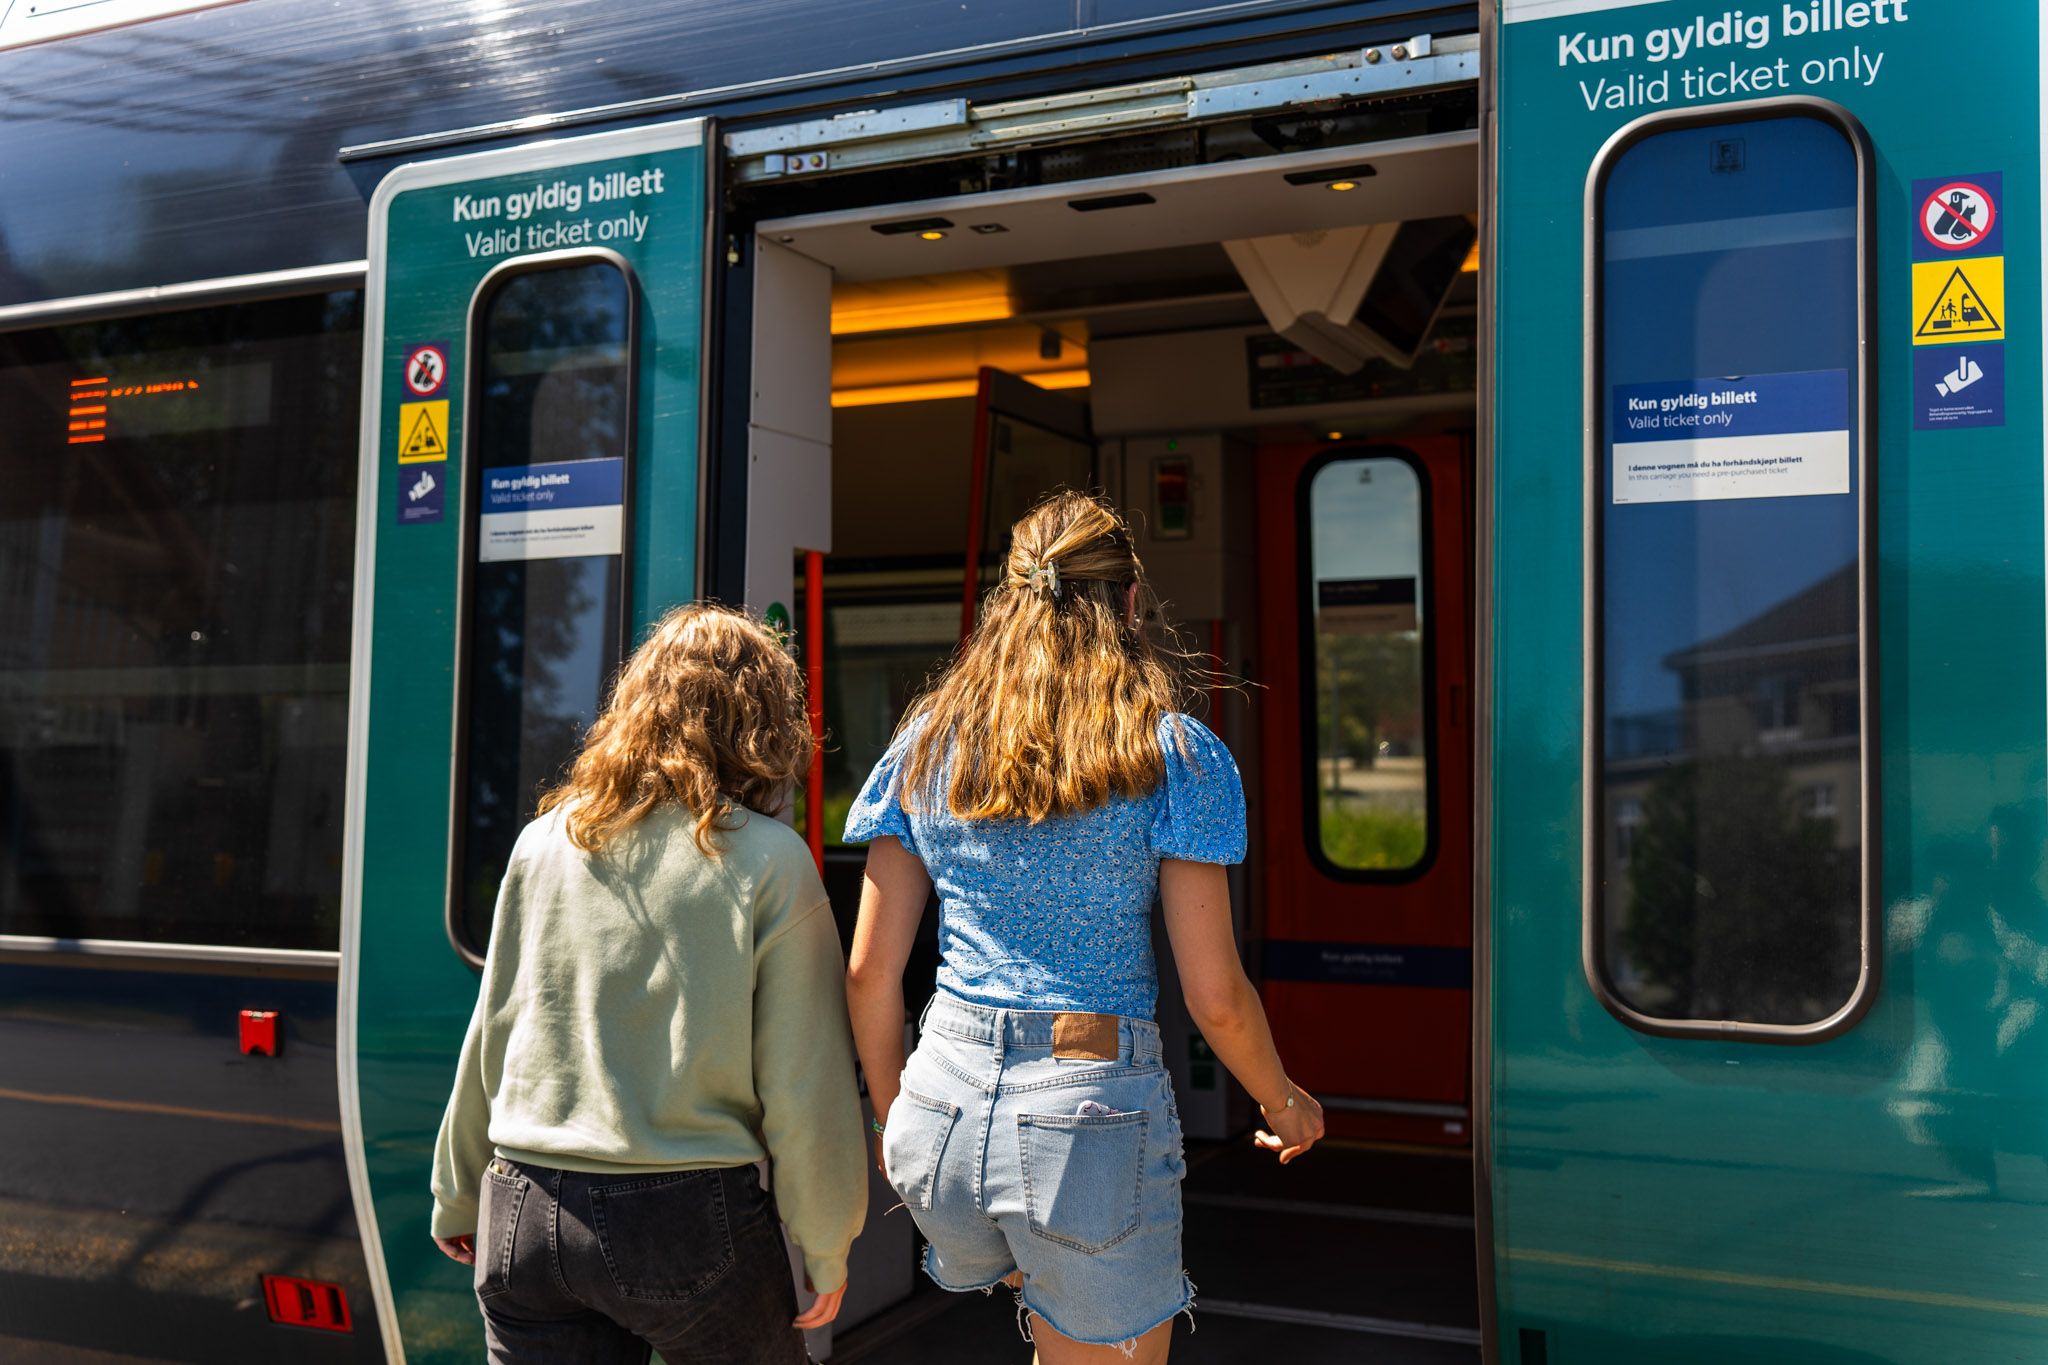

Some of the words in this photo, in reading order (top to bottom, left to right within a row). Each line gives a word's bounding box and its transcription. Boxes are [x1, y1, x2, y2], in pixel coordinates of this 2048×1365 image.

[1557, 31, 1635, 66] Kun
[1645, 11, 1769, 61] gyldig
[1781, 0, 1910, 37] billett
[1579, 69, 1670, 112] Valid
[1680, 57, 1791, 99] ticket
[1800, 45, 1885, 86] only
[452, 194, 501, 223] Kun
[505, 180, 583, 220] gyldig
[587, 167, 665, 202] billett
[465, 225, 521, 258] Valid
[526, 218, 593, 250] ticket
[597, 209, 649, 243] only
[1628, 397, 1658, 411] Kun
[1660, 391, 1708, 412] gyldig
[1711, 390, 1758, 407] billett
[1628, 415, 1660, 430] Valid
[1663, 412, 1700, 427] ticket
[1703, 411, 1733, 427] only
[1632, 464, 1656, 472] denne
[1657, 462, 1686, 471] vognen
[1779, 456, 1803, 465] billett
[491, 478, 510, 488] Kun
[511, 475, 540, 490] gyldig
[541, 474, 570, 485] billett
[535, 489, 554, 502] only
